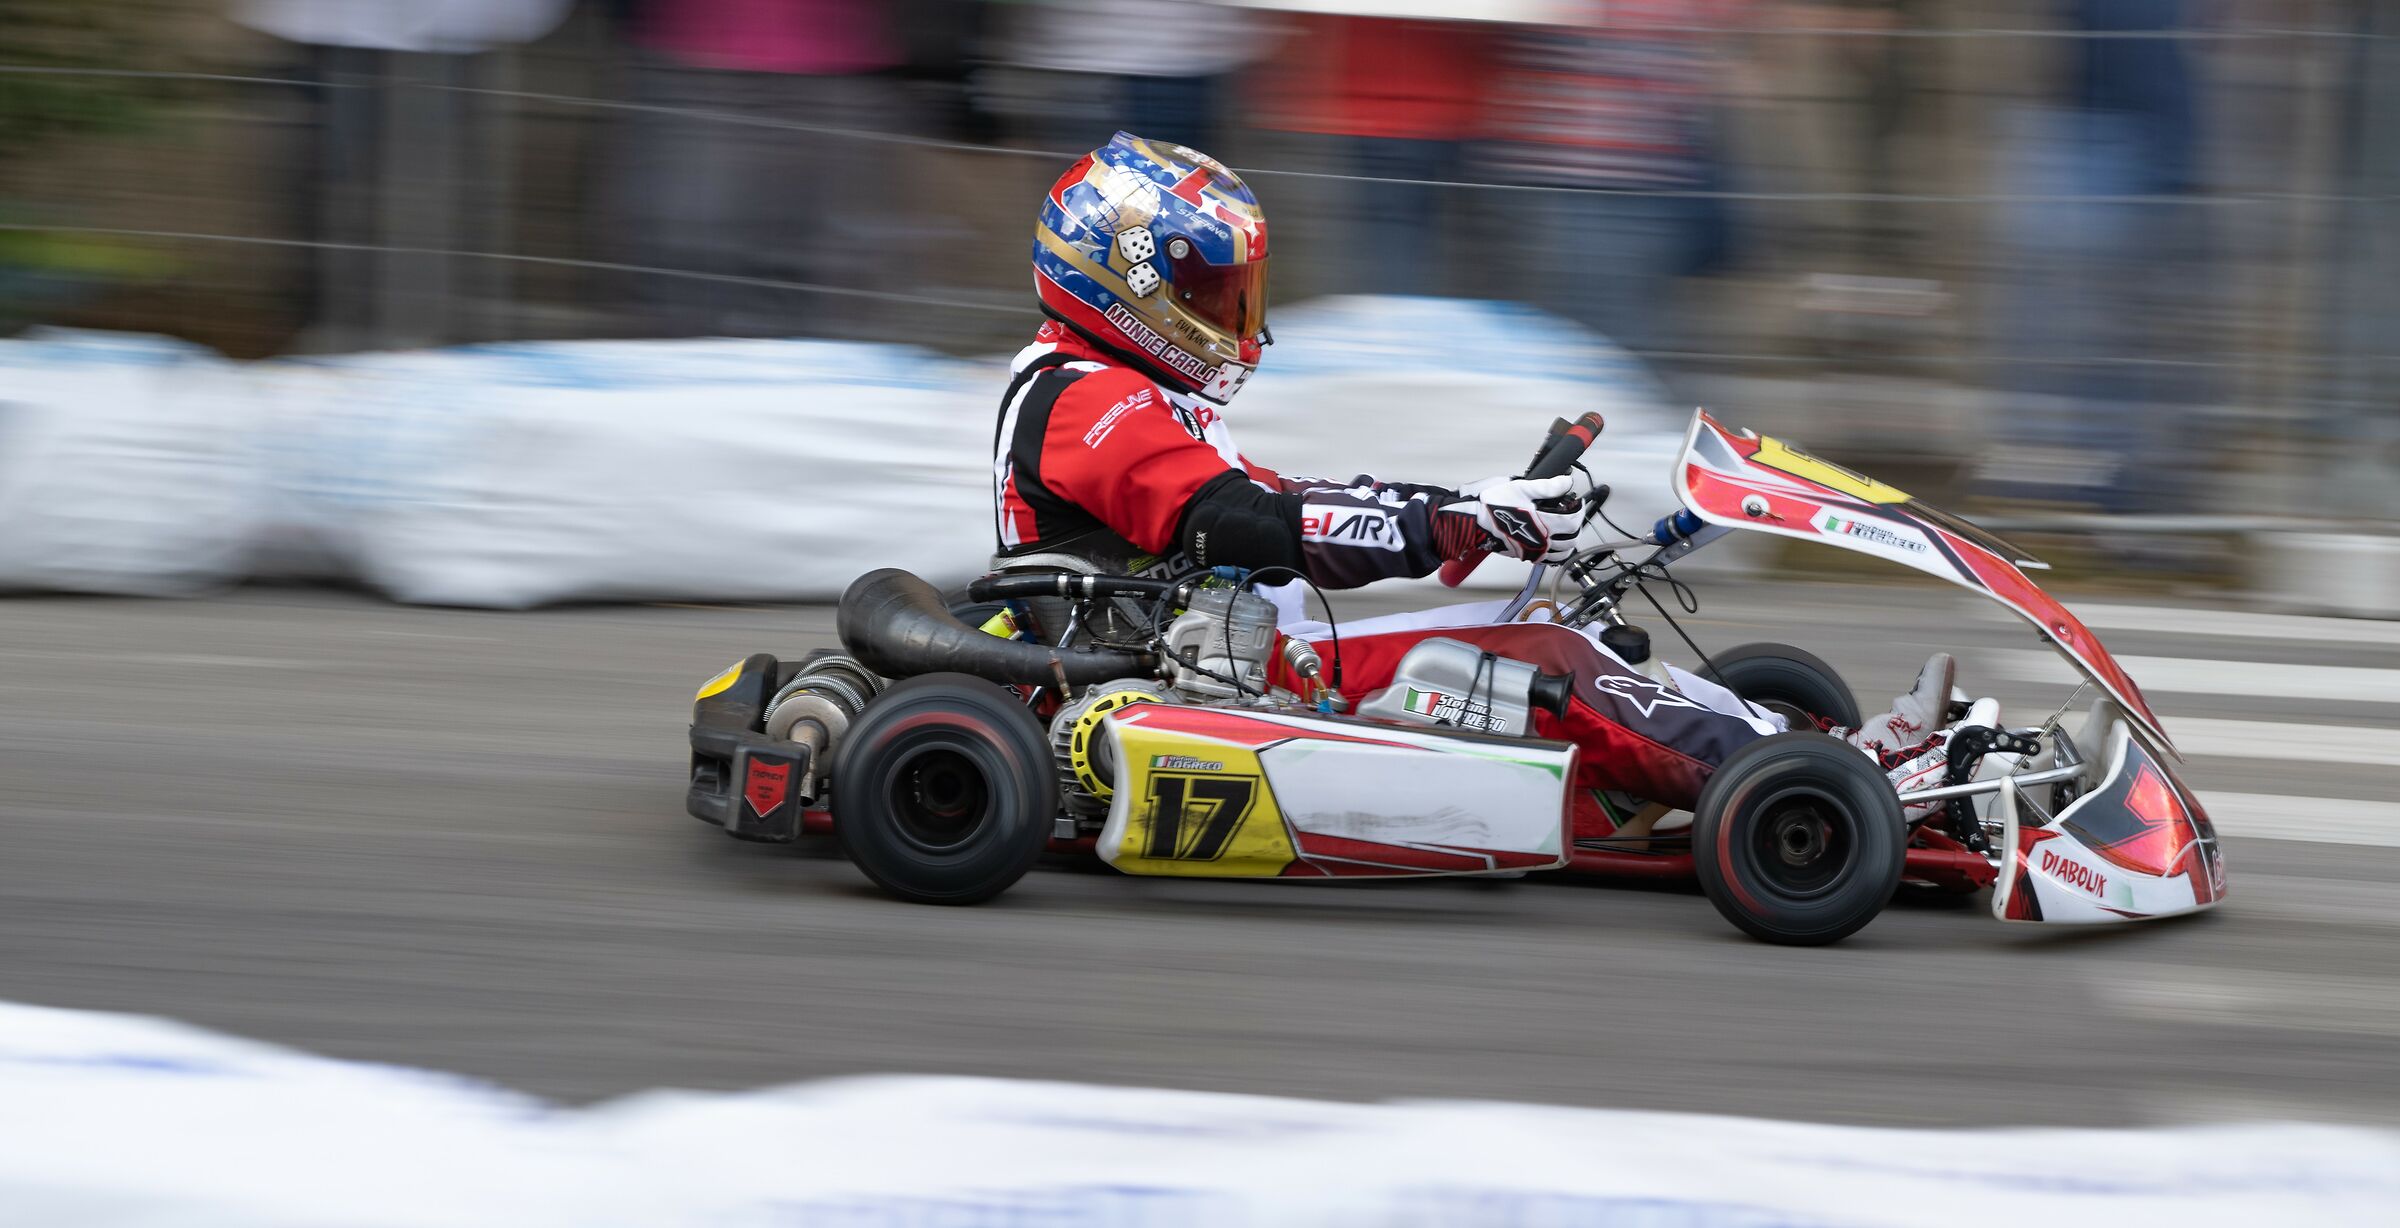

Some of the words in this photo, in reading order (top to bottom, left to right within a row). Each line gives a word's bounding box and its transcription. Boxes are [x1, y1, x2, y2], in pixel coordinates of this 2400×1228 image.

[1104, 302, 1168, 356] MONTE
[1159, 344, 1219, 385] CARLO
[1175, 319, 1189, 333] EVA
[1082, 387, 1153, 446] FREELINE
[1166, 760, 1223, 771] LOGRECO
[1143, 771, 1259, 861] 17
[2041, 849, 2107, 898] DIABOLIK
